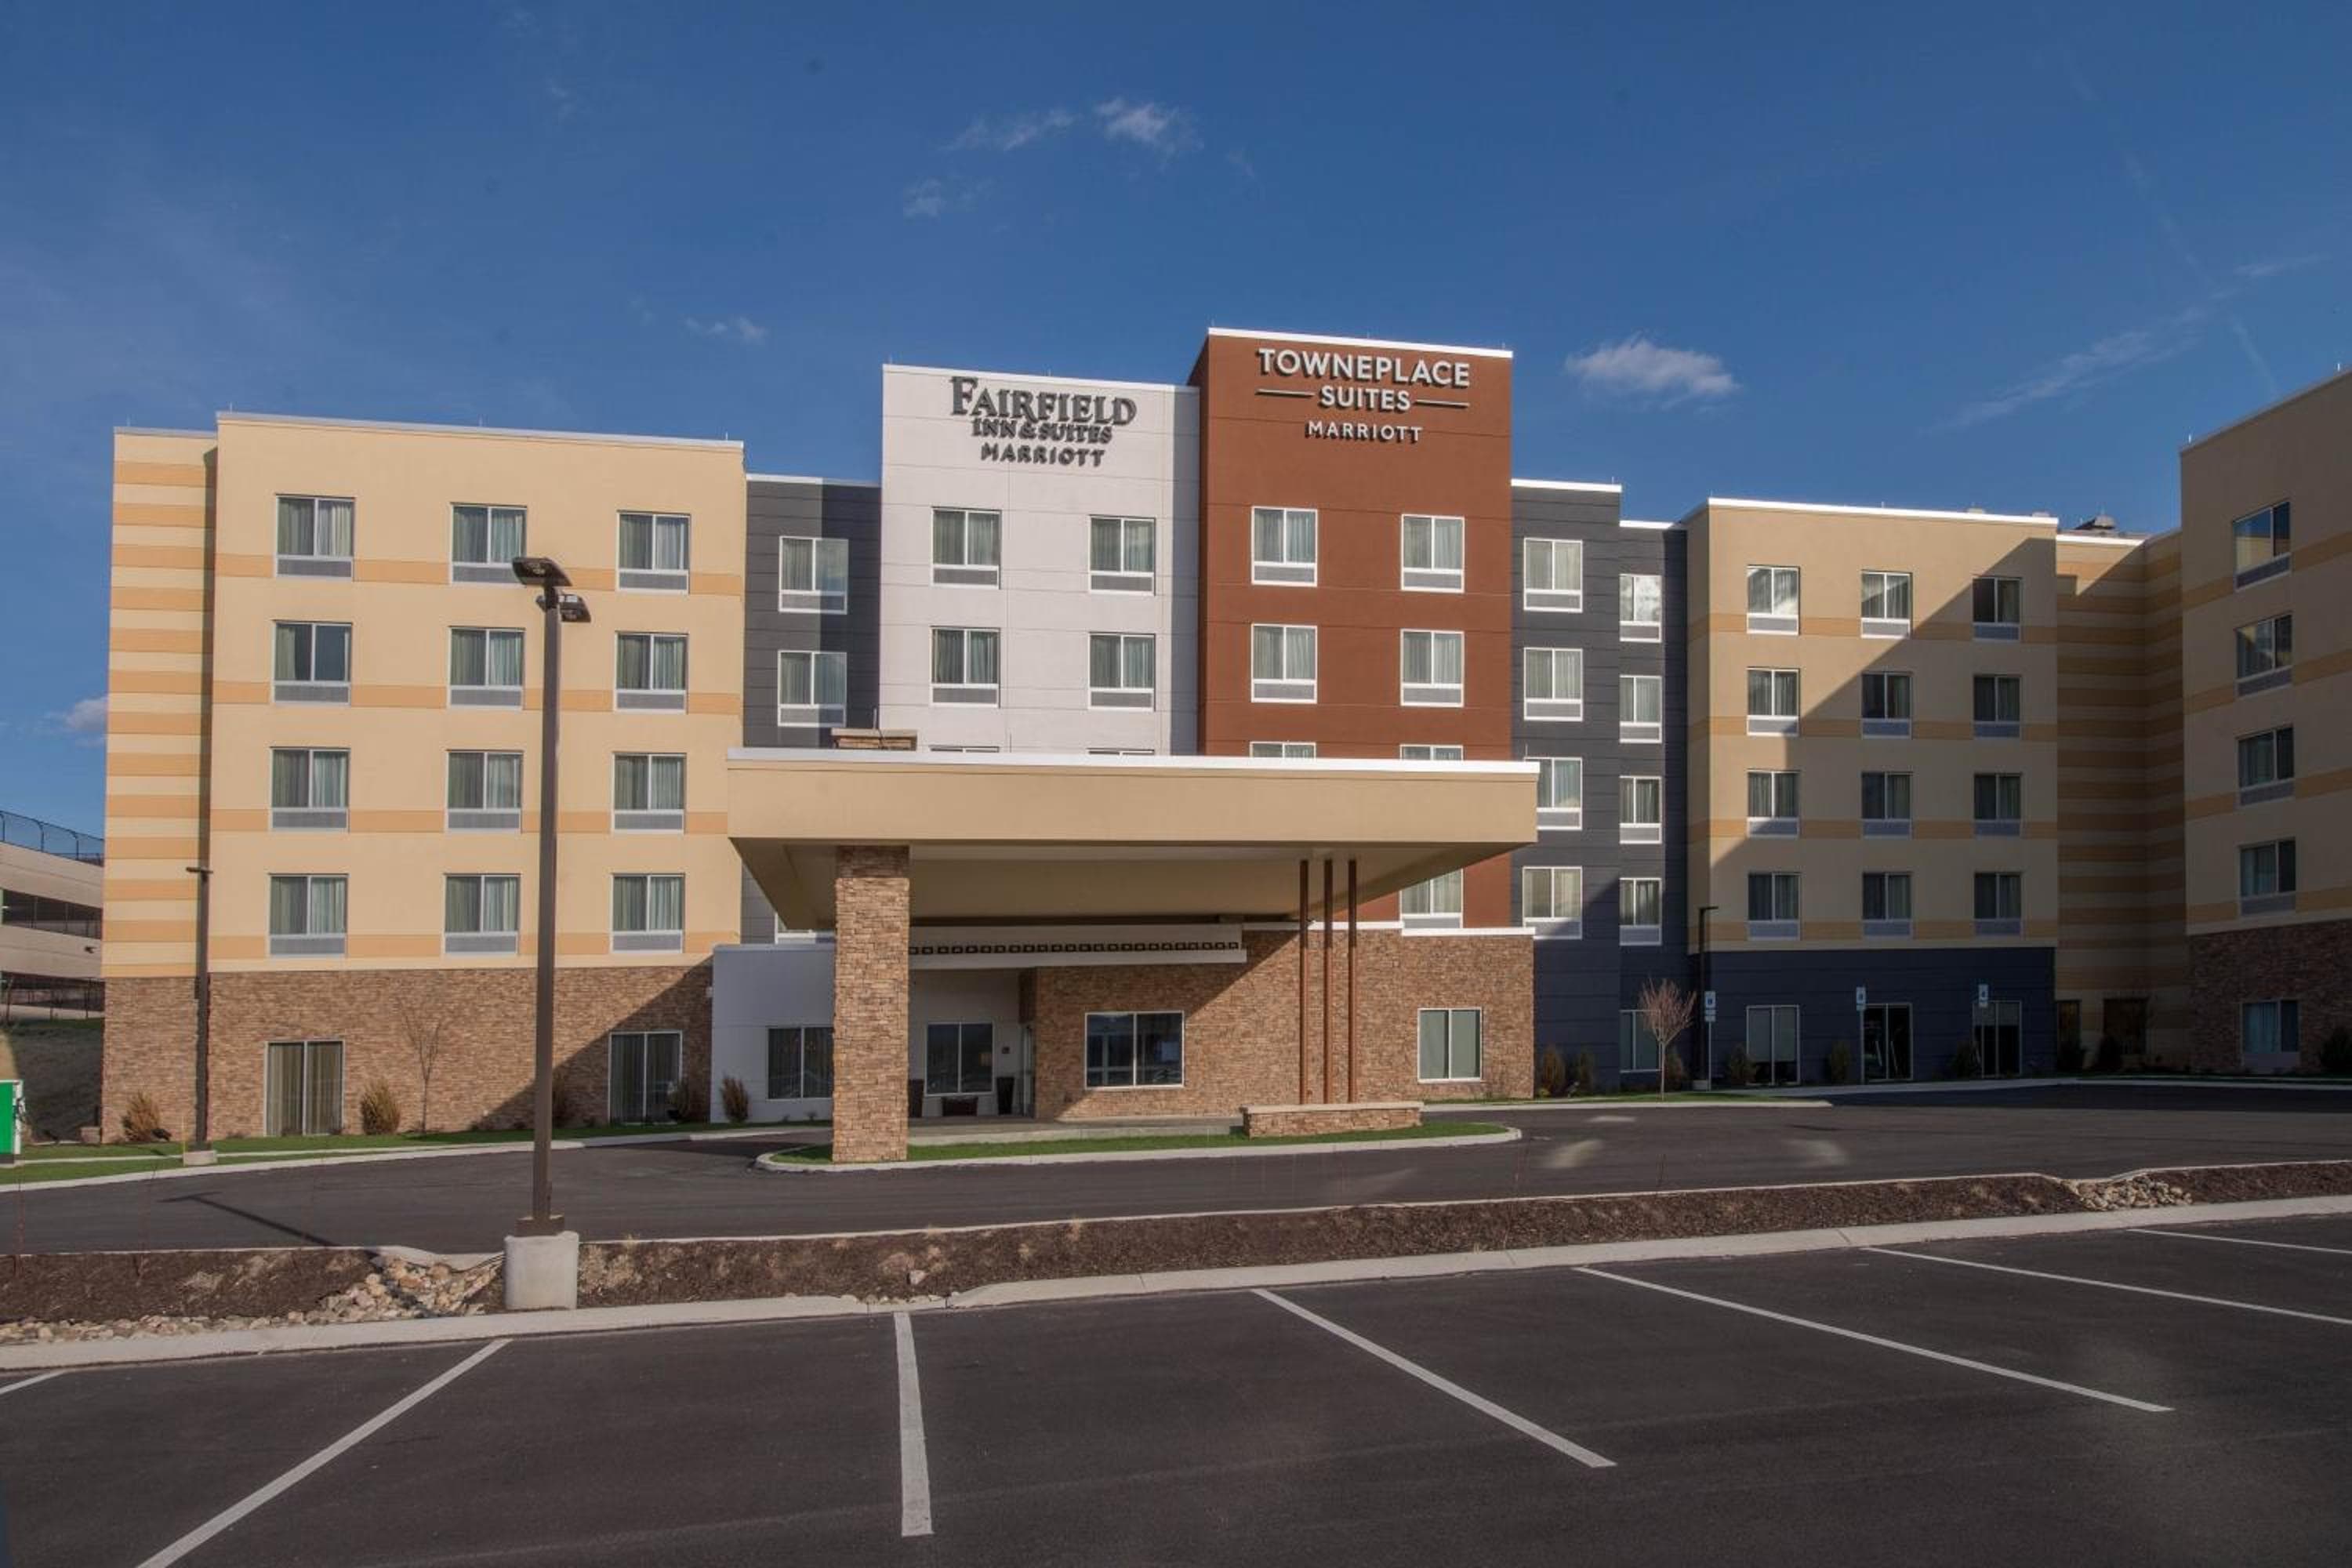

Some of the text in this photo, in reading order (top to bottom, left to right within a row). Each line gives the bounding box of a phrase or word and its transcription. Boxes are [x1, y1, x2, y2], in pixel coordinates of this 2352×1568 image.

[1257, 347, 1471, 387] TOWNEPLACE
[949, 376, 1137, 426] FAIRFIELD
[1319, 385, 1411, 411] SUITES
[1307, 420, 1423, 443] MARRIOTT
[981, 442, 1105, 467] MARRIOTT
